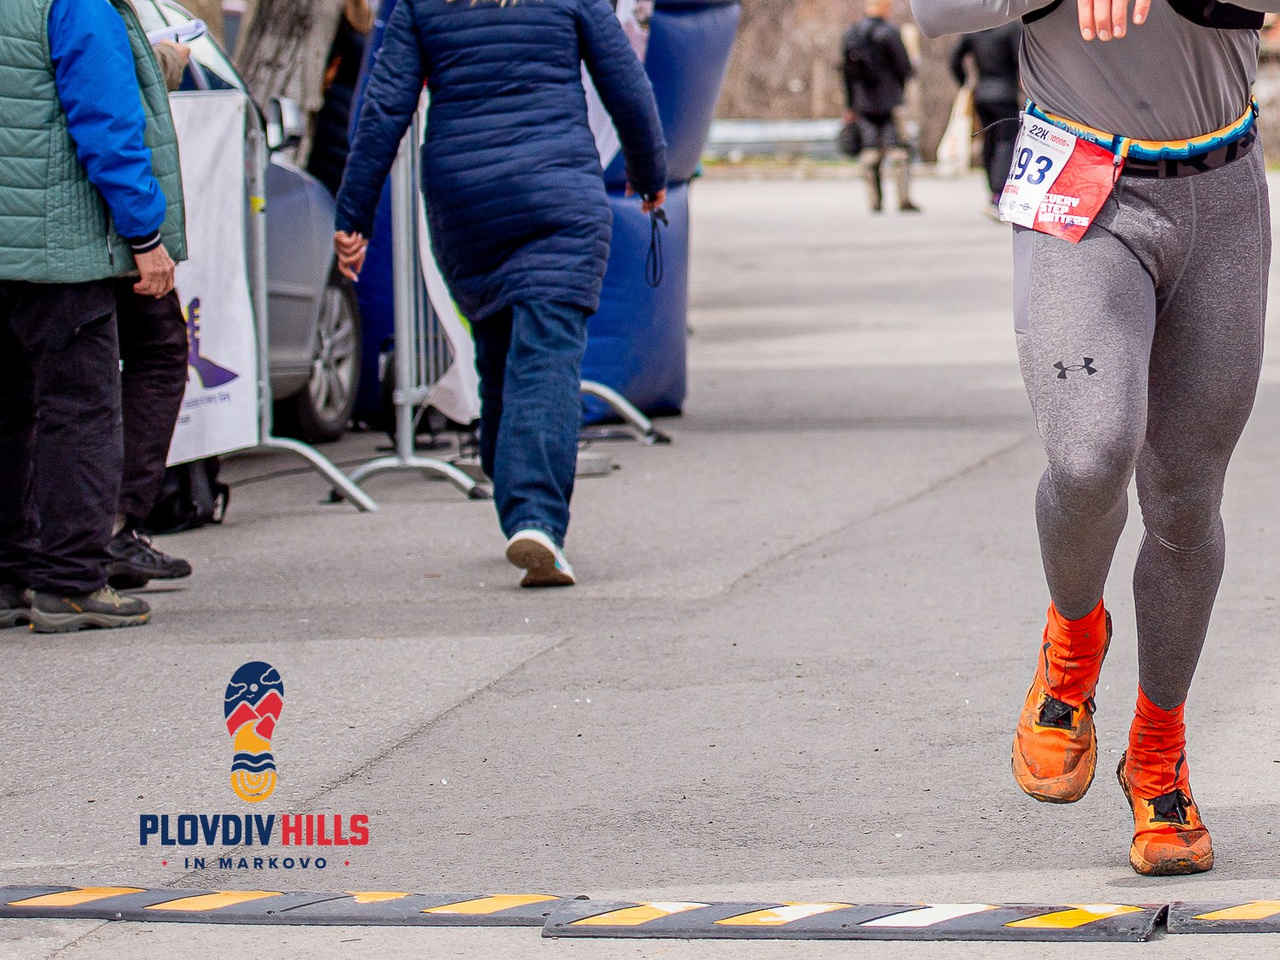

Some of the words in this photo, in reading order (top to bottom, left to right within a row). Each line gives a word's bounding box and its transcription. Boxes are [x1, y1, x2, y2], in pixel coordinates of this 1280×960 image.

[1029, 124, 1050, 141] 22K
[1012, 147, 1053, 185] 93
[1044, 193, 1080, 207] EVERY
[1040, 203, 1069, 216] STEP
[1038, 212, 1090, 227] MATTERS
